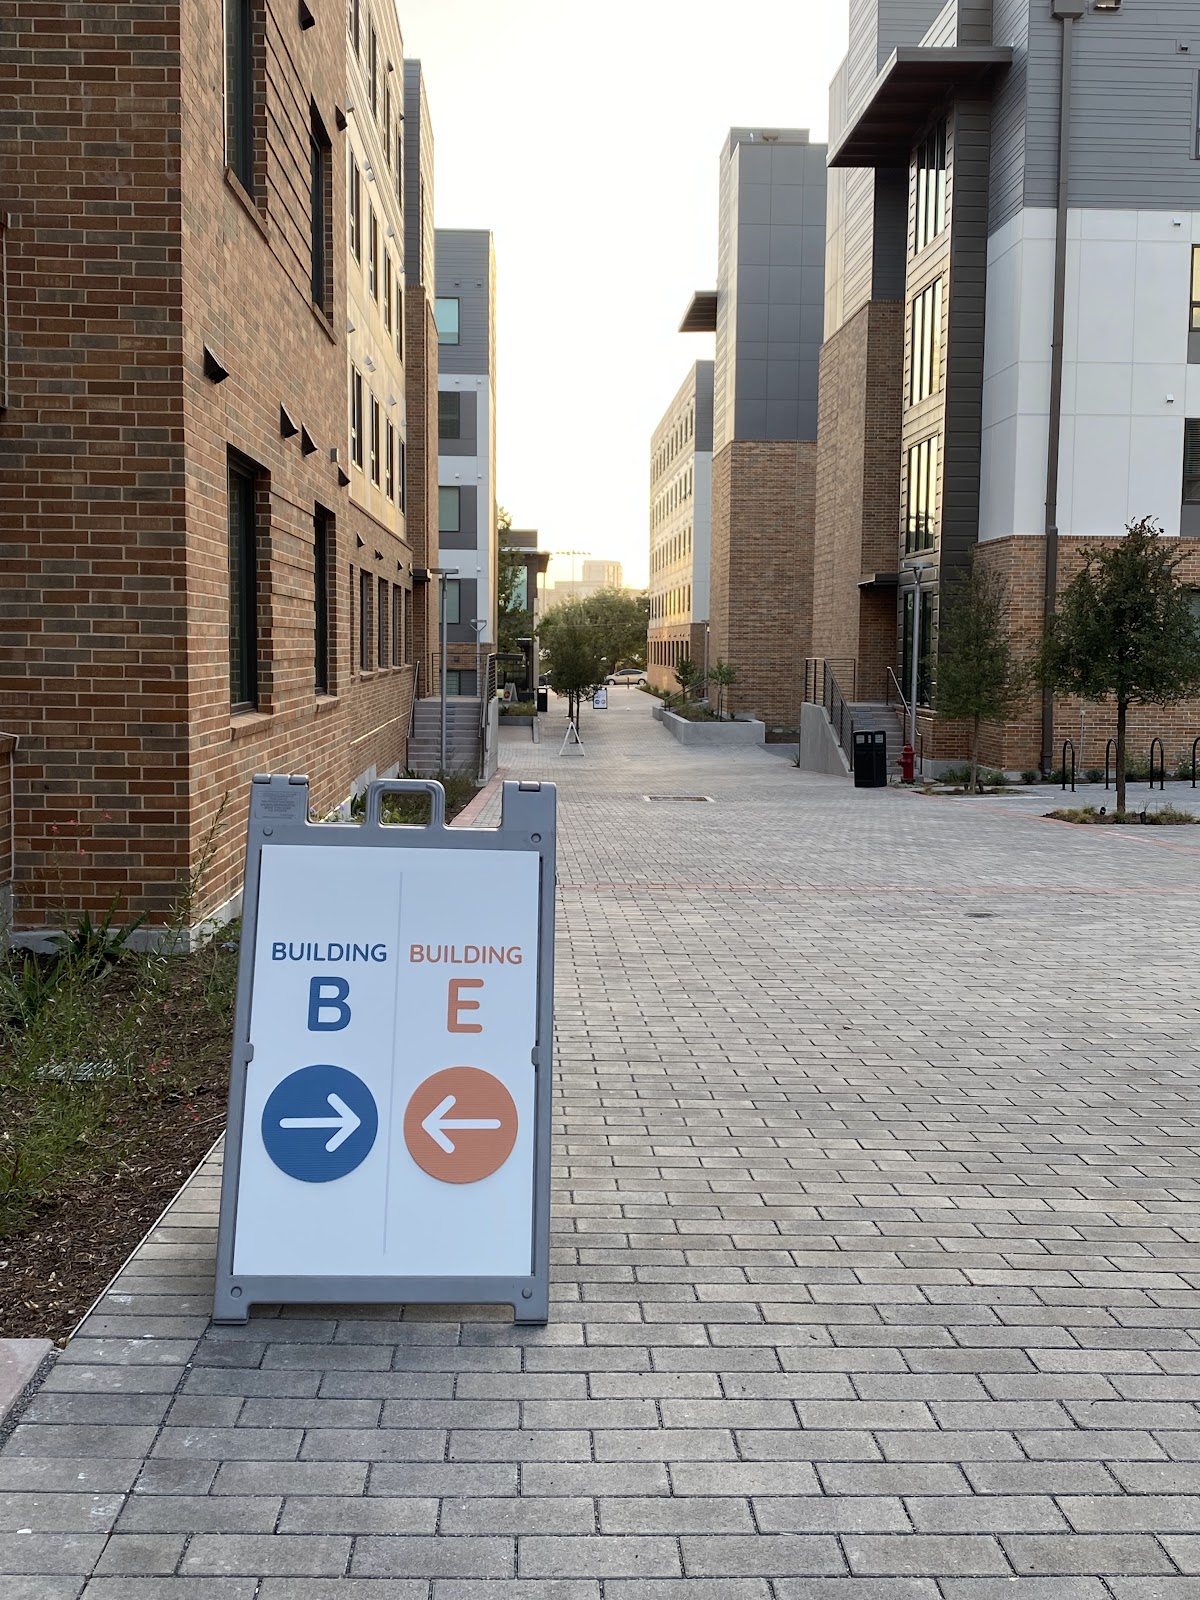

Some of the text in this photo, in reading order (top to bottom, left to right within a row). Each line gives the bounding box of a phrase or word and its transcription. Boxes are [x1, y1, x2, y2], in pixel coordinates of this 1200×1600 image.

[271, 942, 387, 962] BUILDING
[409, 944, 523, 965] BUILDING
[307, 976, 352, 1032] B
[446, 978, 485, 1033] E
